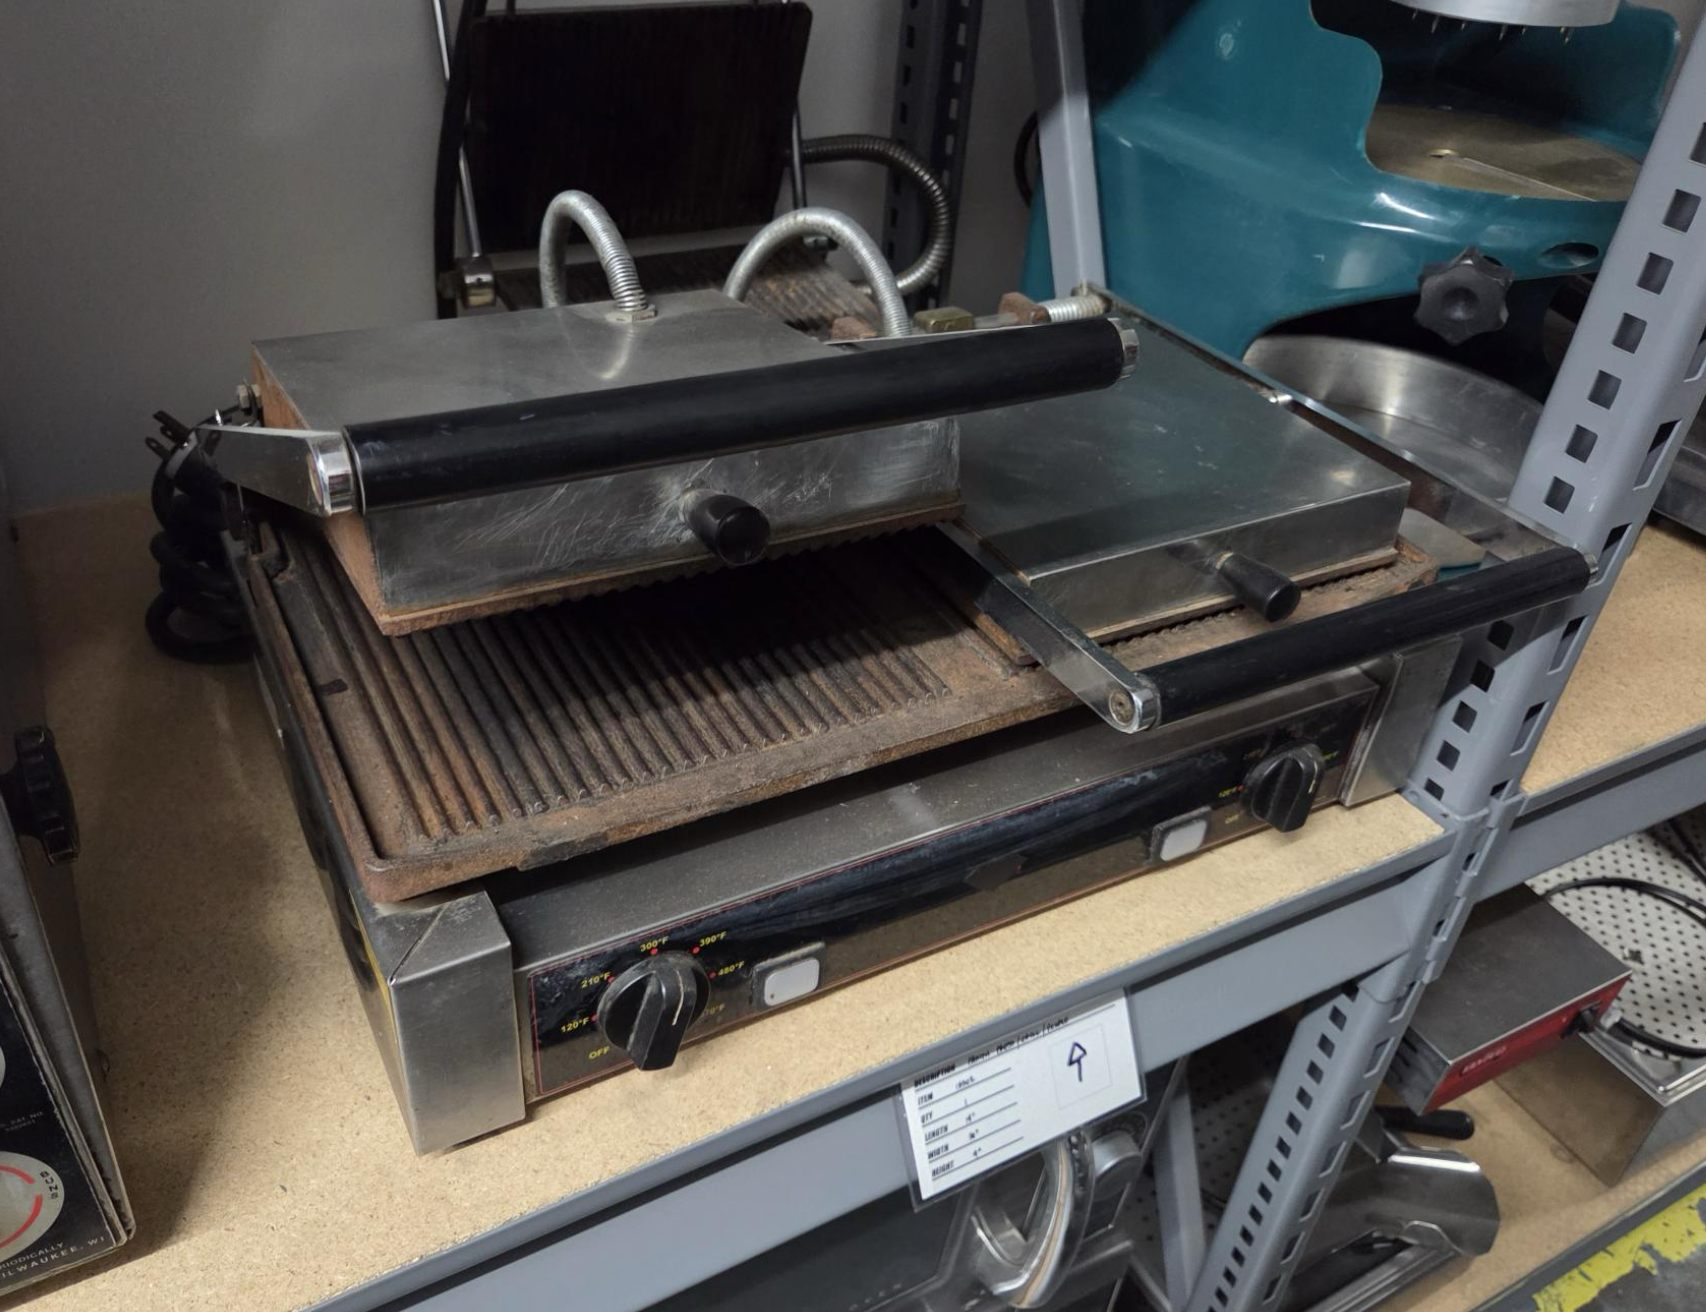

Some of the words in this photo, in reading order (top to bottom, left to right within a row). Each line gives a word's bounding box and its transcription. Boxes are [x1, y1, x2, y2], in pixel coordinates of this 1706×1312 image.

[640, 936, 669, 952] 300°F
[699, 931, 727, 947] 390°F
[718, 960, 745, 976] 480°F
[581, 972, 611, 989] 210°F
[561, 1017, 590, 1034] 120°F
[589, 1047, 609, 1060] OFF
[914, 1063, 956, 1088] DESCRIPTION
[917, 1092, 934, 1106] ITEM
[920, 1111, 933, 1124] QTY
[924, 1124, 949, 1142] LENGTH
[927, 1144, 950, 1160] WIDTH
[931, 1160, 955, 1177] HEIGHT
[40, 1170, 59, 1200] BUNS
